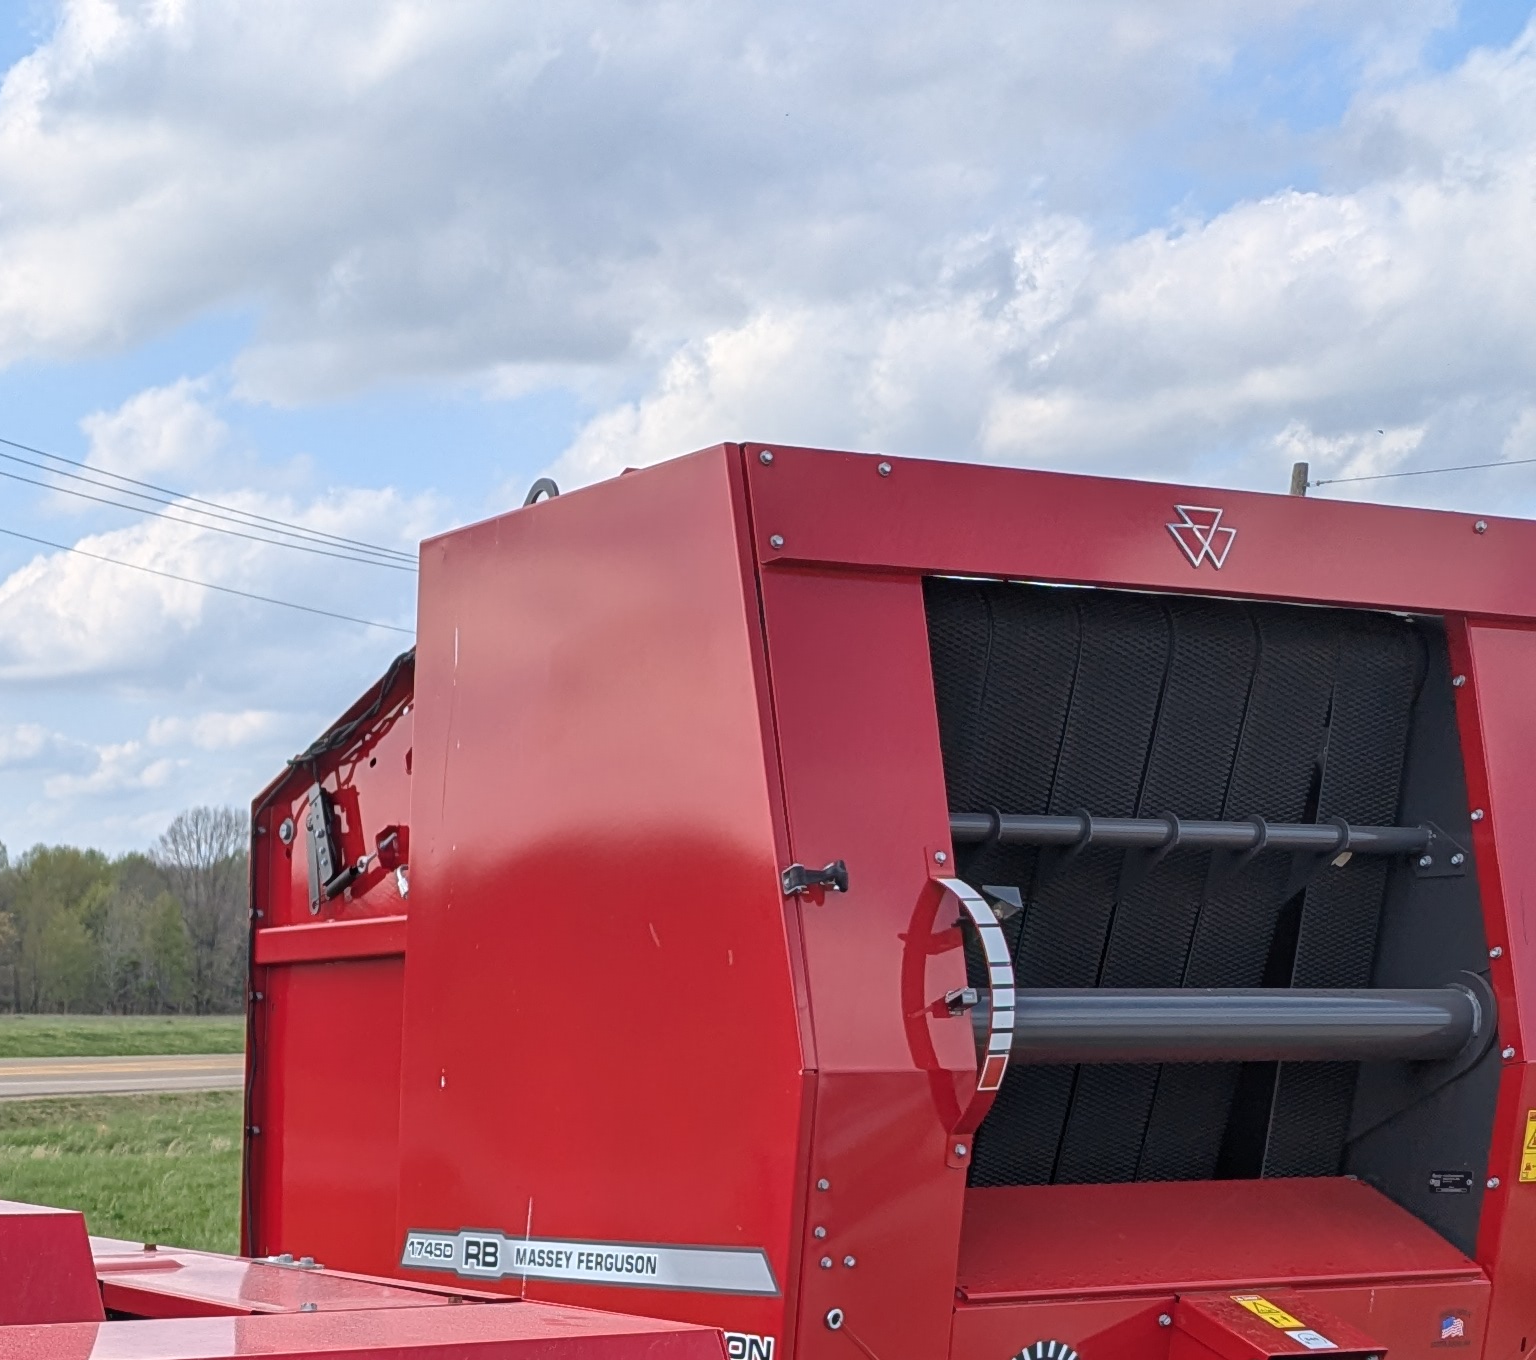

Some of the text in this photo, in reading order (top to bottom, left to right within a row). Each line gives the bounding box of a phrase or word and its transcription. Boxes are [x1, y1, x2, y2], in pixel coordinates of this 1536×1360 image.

[408, 1238, 454, 1260] 1745D
[463, 1238, 499, 1268] RB
[515, 1247, 658, 1275] MASSEY FERGUSON
